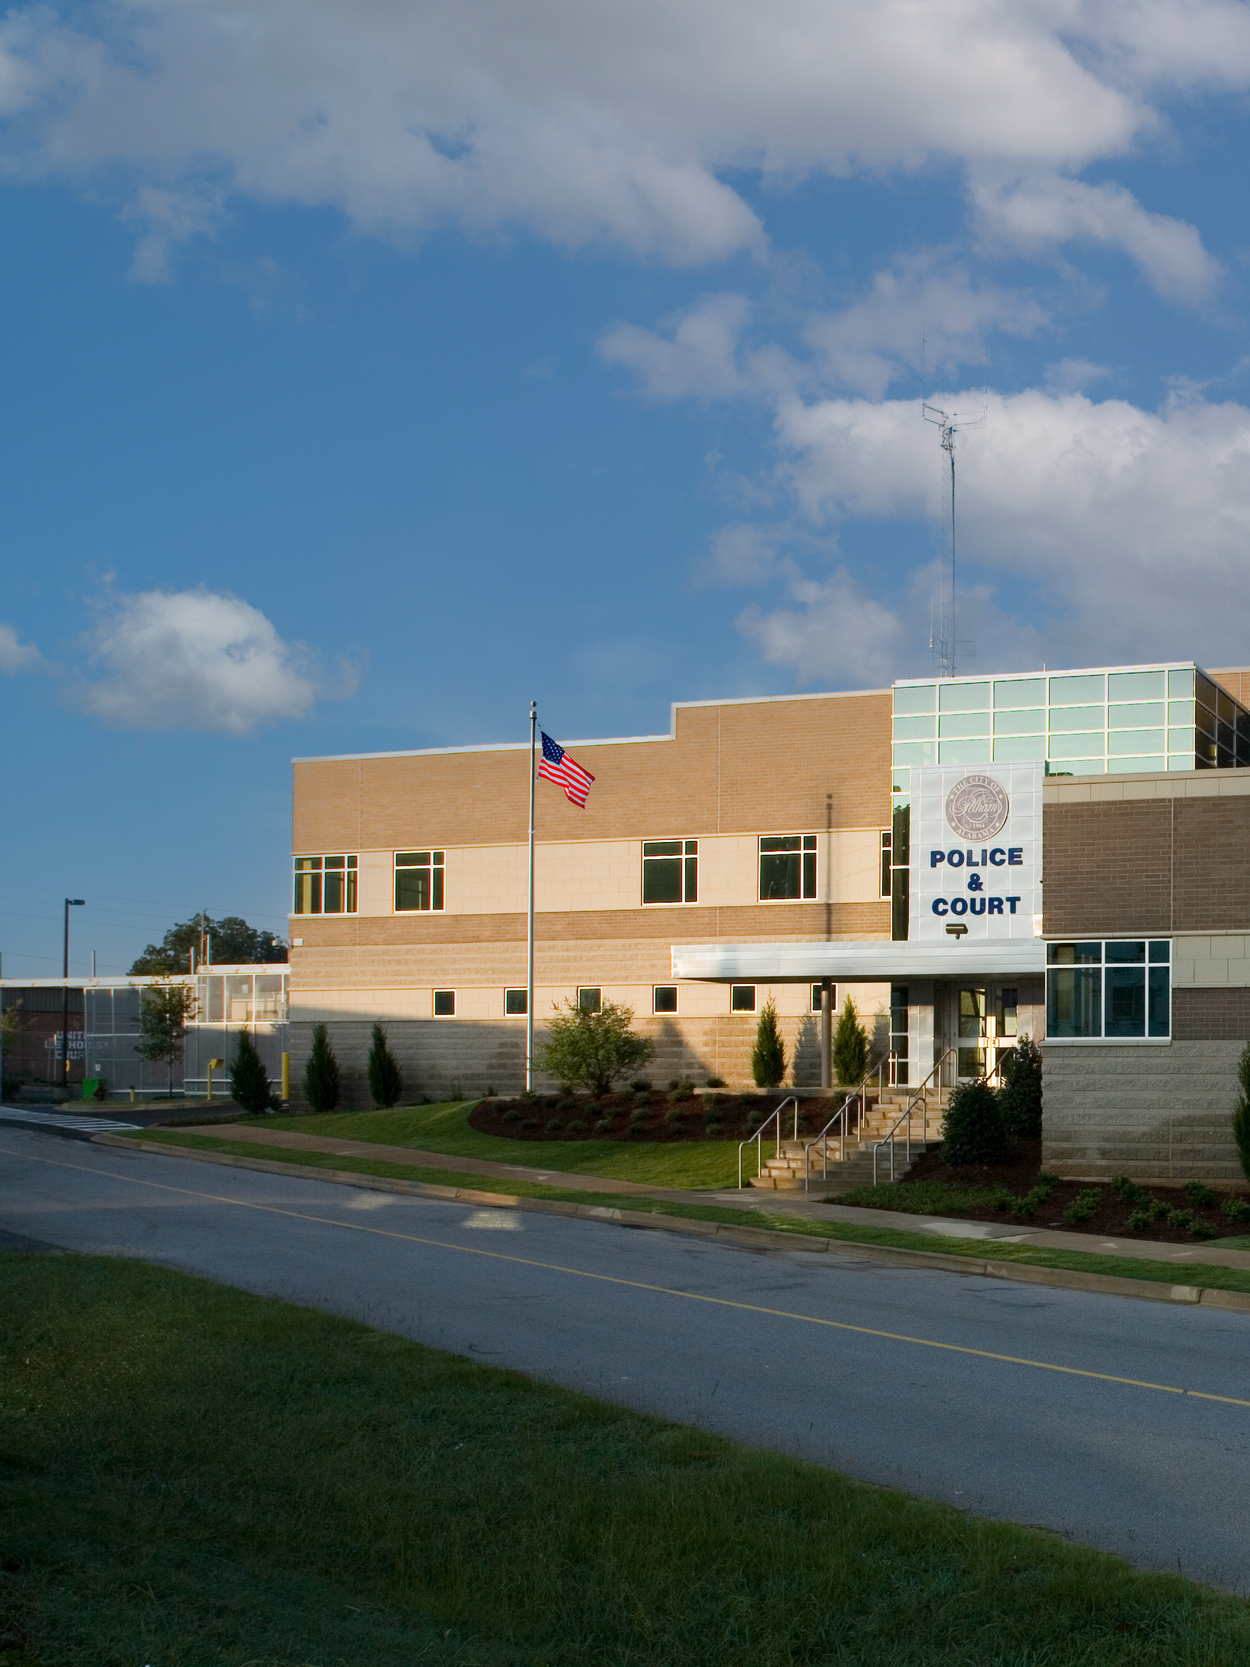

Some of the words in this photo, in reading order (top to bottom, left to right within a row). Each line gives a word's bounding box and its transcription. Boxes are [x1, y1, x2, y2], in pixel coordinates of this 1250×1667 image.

[953, 779, 967, 793] THE
[970, 776, 988, 784] CITY
[991, 782, 1000, 792] OF
[956, 829, 995, 839] ALABAMA
[930, 848, 1023, 868] POLICE
[967, 873, 984, 891] &
[931, 896, 1021, 915] COURT
[44, 1040, 109, 1049] EHODIST
